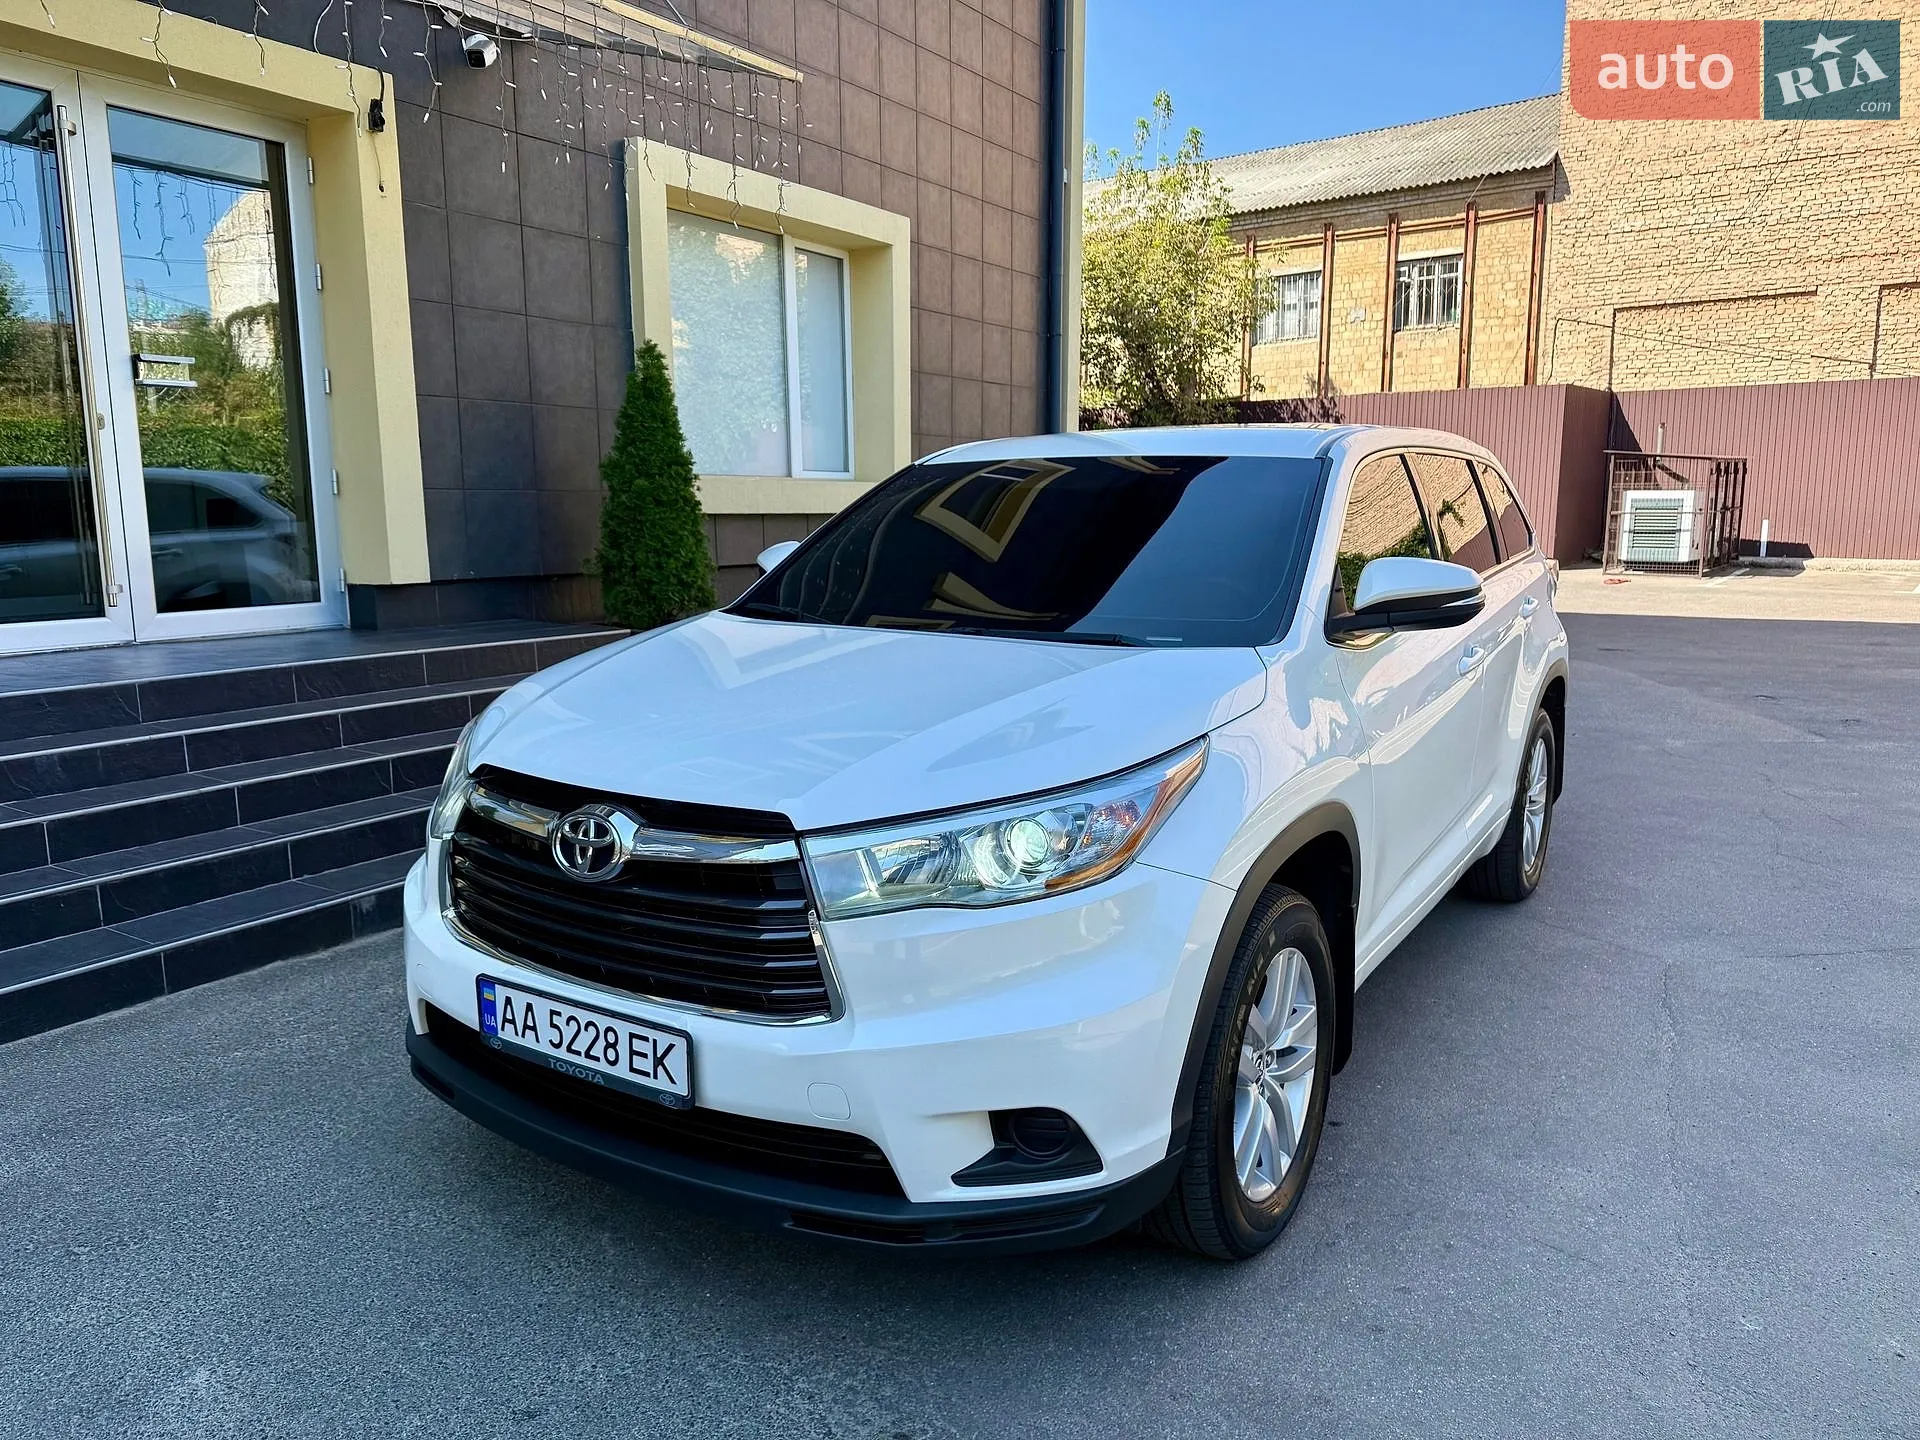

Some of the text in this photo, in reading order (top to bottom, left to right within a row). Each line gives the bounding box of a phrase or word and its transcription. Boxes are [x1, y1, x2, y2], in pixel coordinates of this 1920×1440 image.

[484, 1013, 497, 1029] UA
[500, 995, 677, 1085] AA 5228 EK
[548, 1058, 605, 1086] TOYOTA
